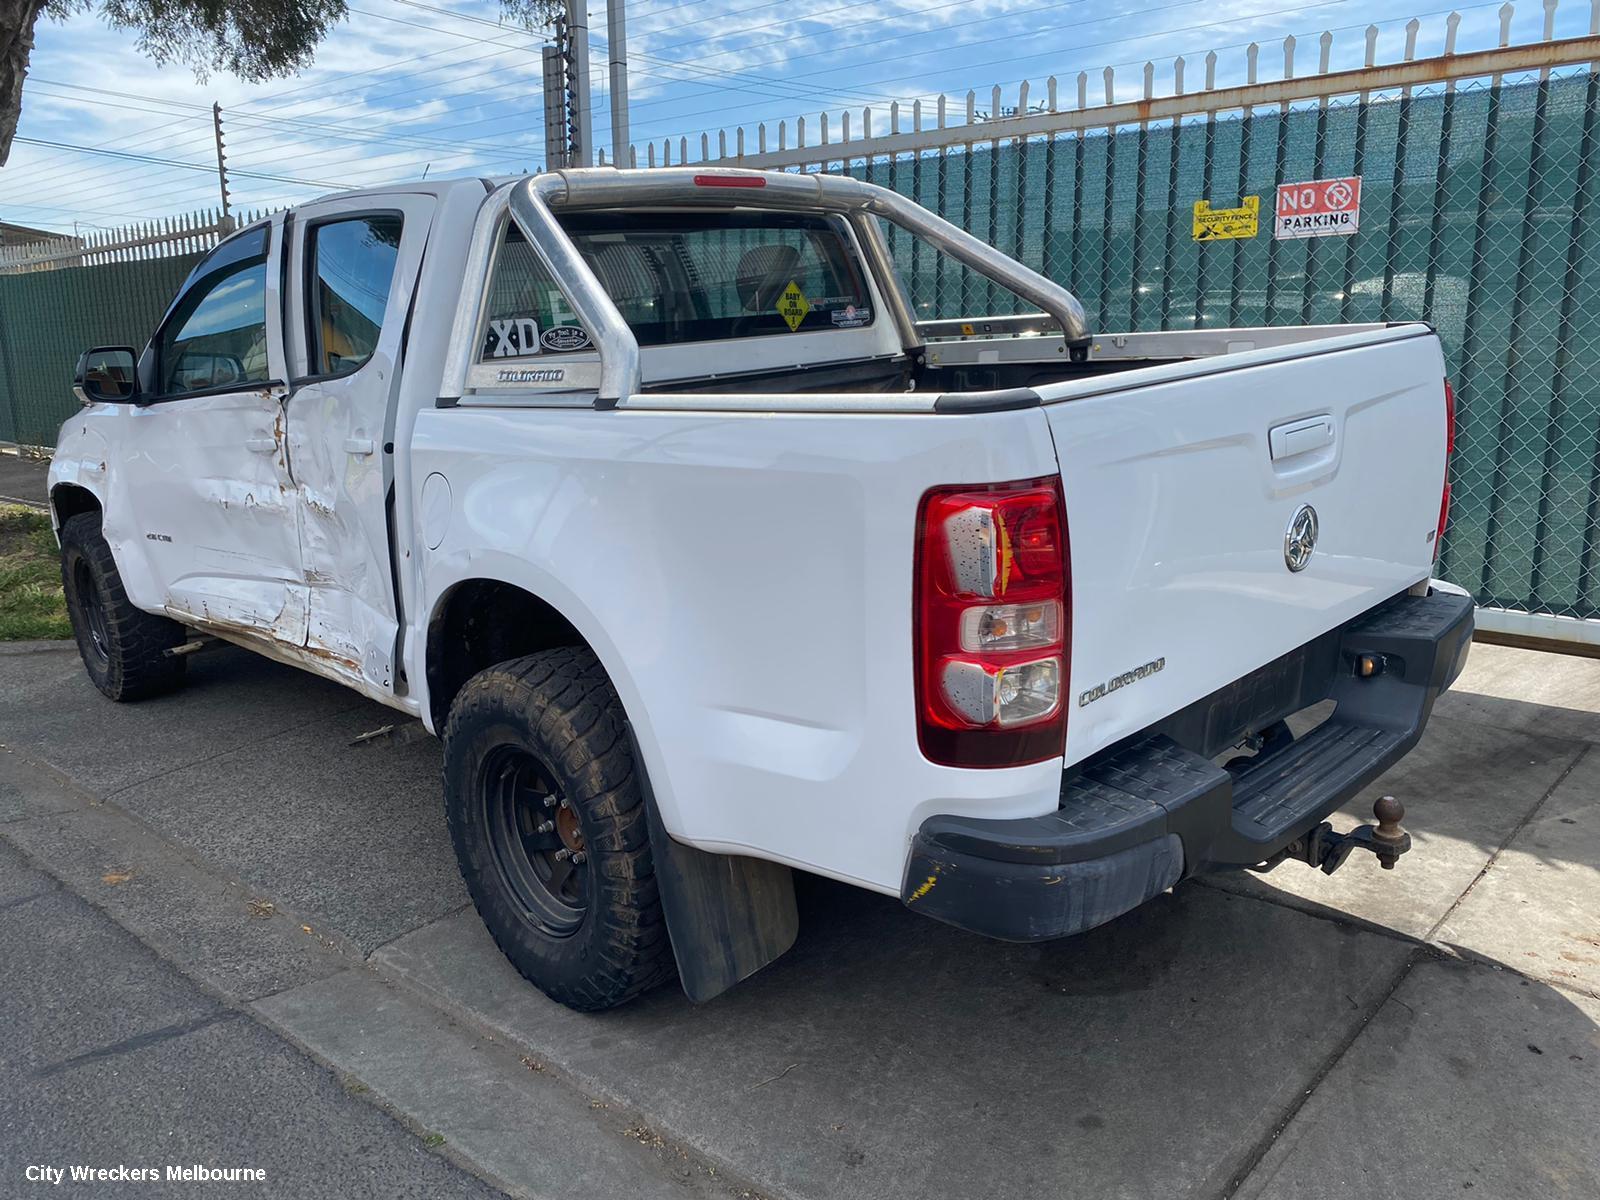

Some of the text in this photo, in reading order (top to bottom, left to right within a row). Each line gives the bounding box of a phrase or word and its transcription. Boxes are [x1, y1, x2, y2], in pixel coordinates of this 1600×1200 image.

[1282, 189, 1315, 211] NO
[1198, 214, 1230, 223] SECURITY
[1231, 213, 1253, 221] FENCE
[1284, 213, 1350, 229] PARKING
[789, 300, 797, 308] ON
[784, 308, 803, 316] BOARD
[496, 370, 564, 382] COLORADO
[1079, 657, 1165, 707] COLORADO
